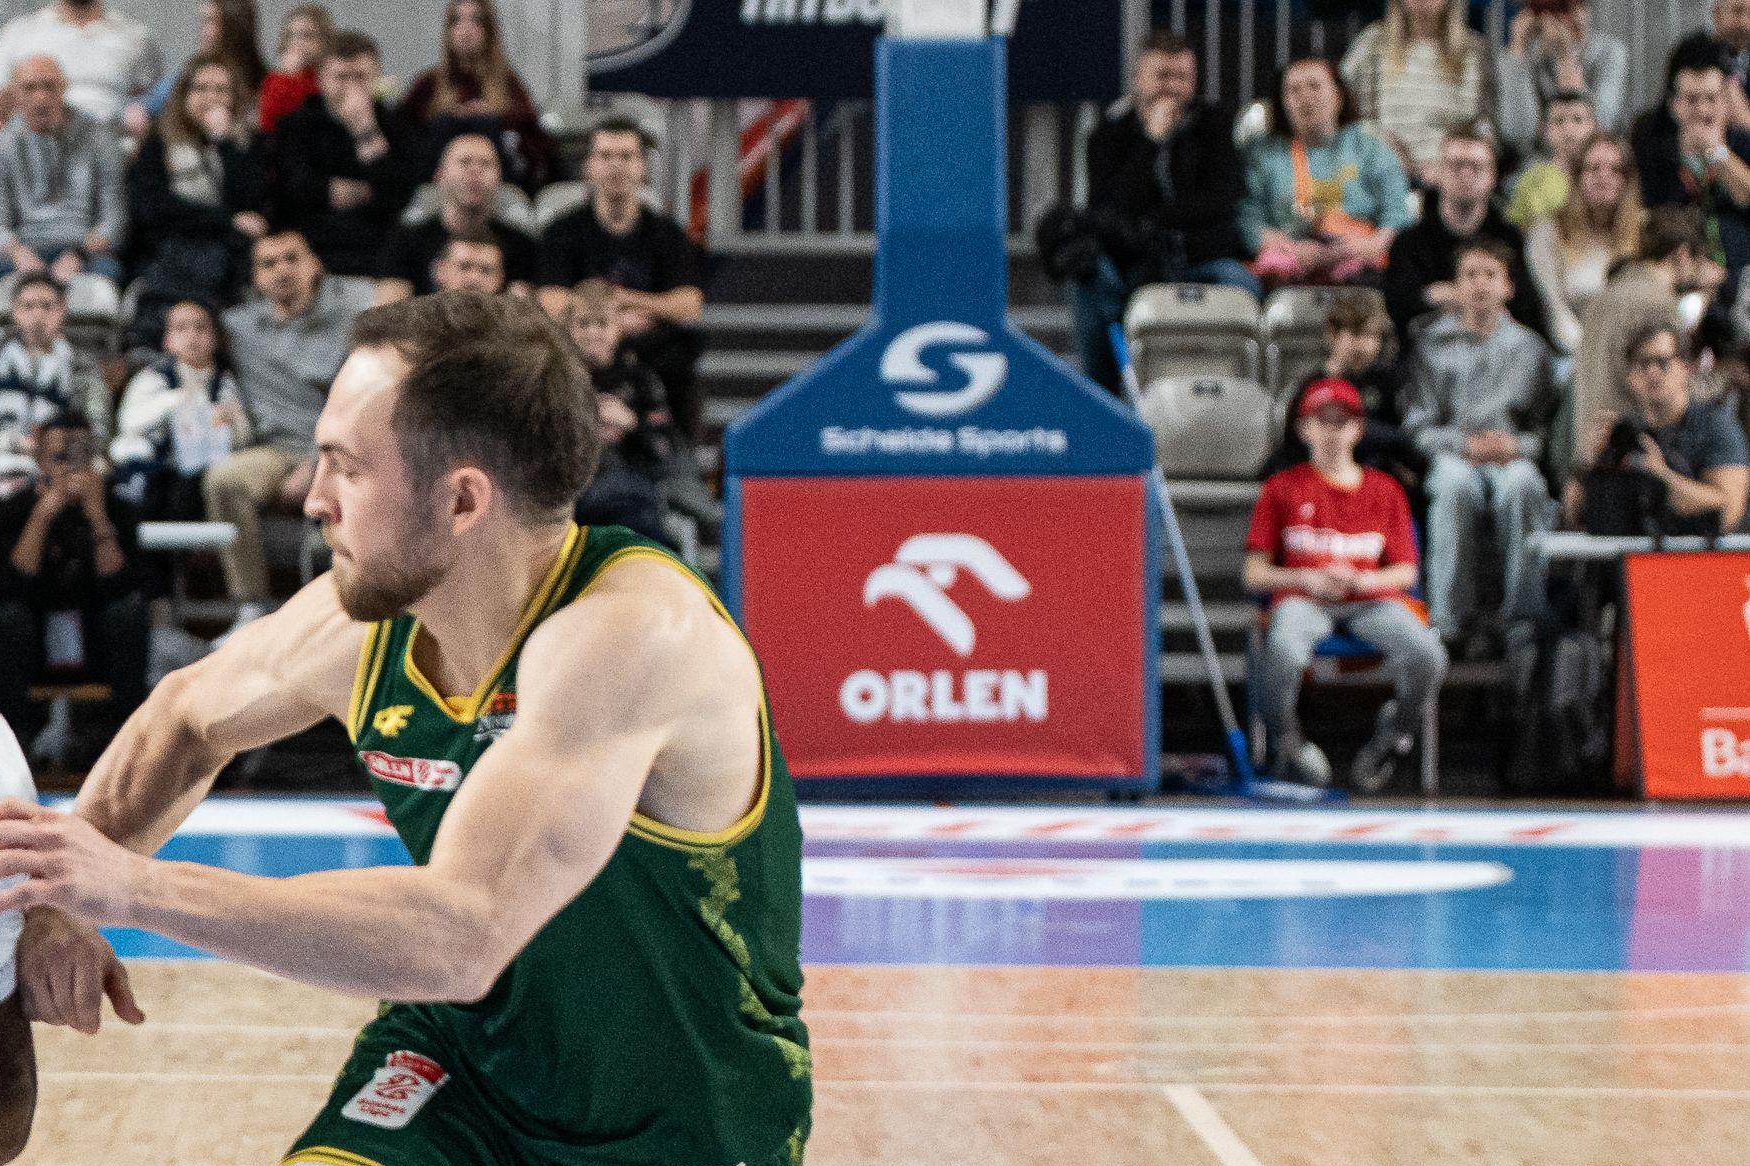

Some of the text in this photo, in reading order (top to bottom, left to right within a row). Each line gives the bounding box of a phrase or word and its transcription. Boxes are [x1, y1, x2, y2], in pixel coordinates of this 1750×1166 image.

[957, 426, 1068, 459] Sports
[839, 668, 1050, 723] ORLEN
[372, 705, 415, 737] 4F
